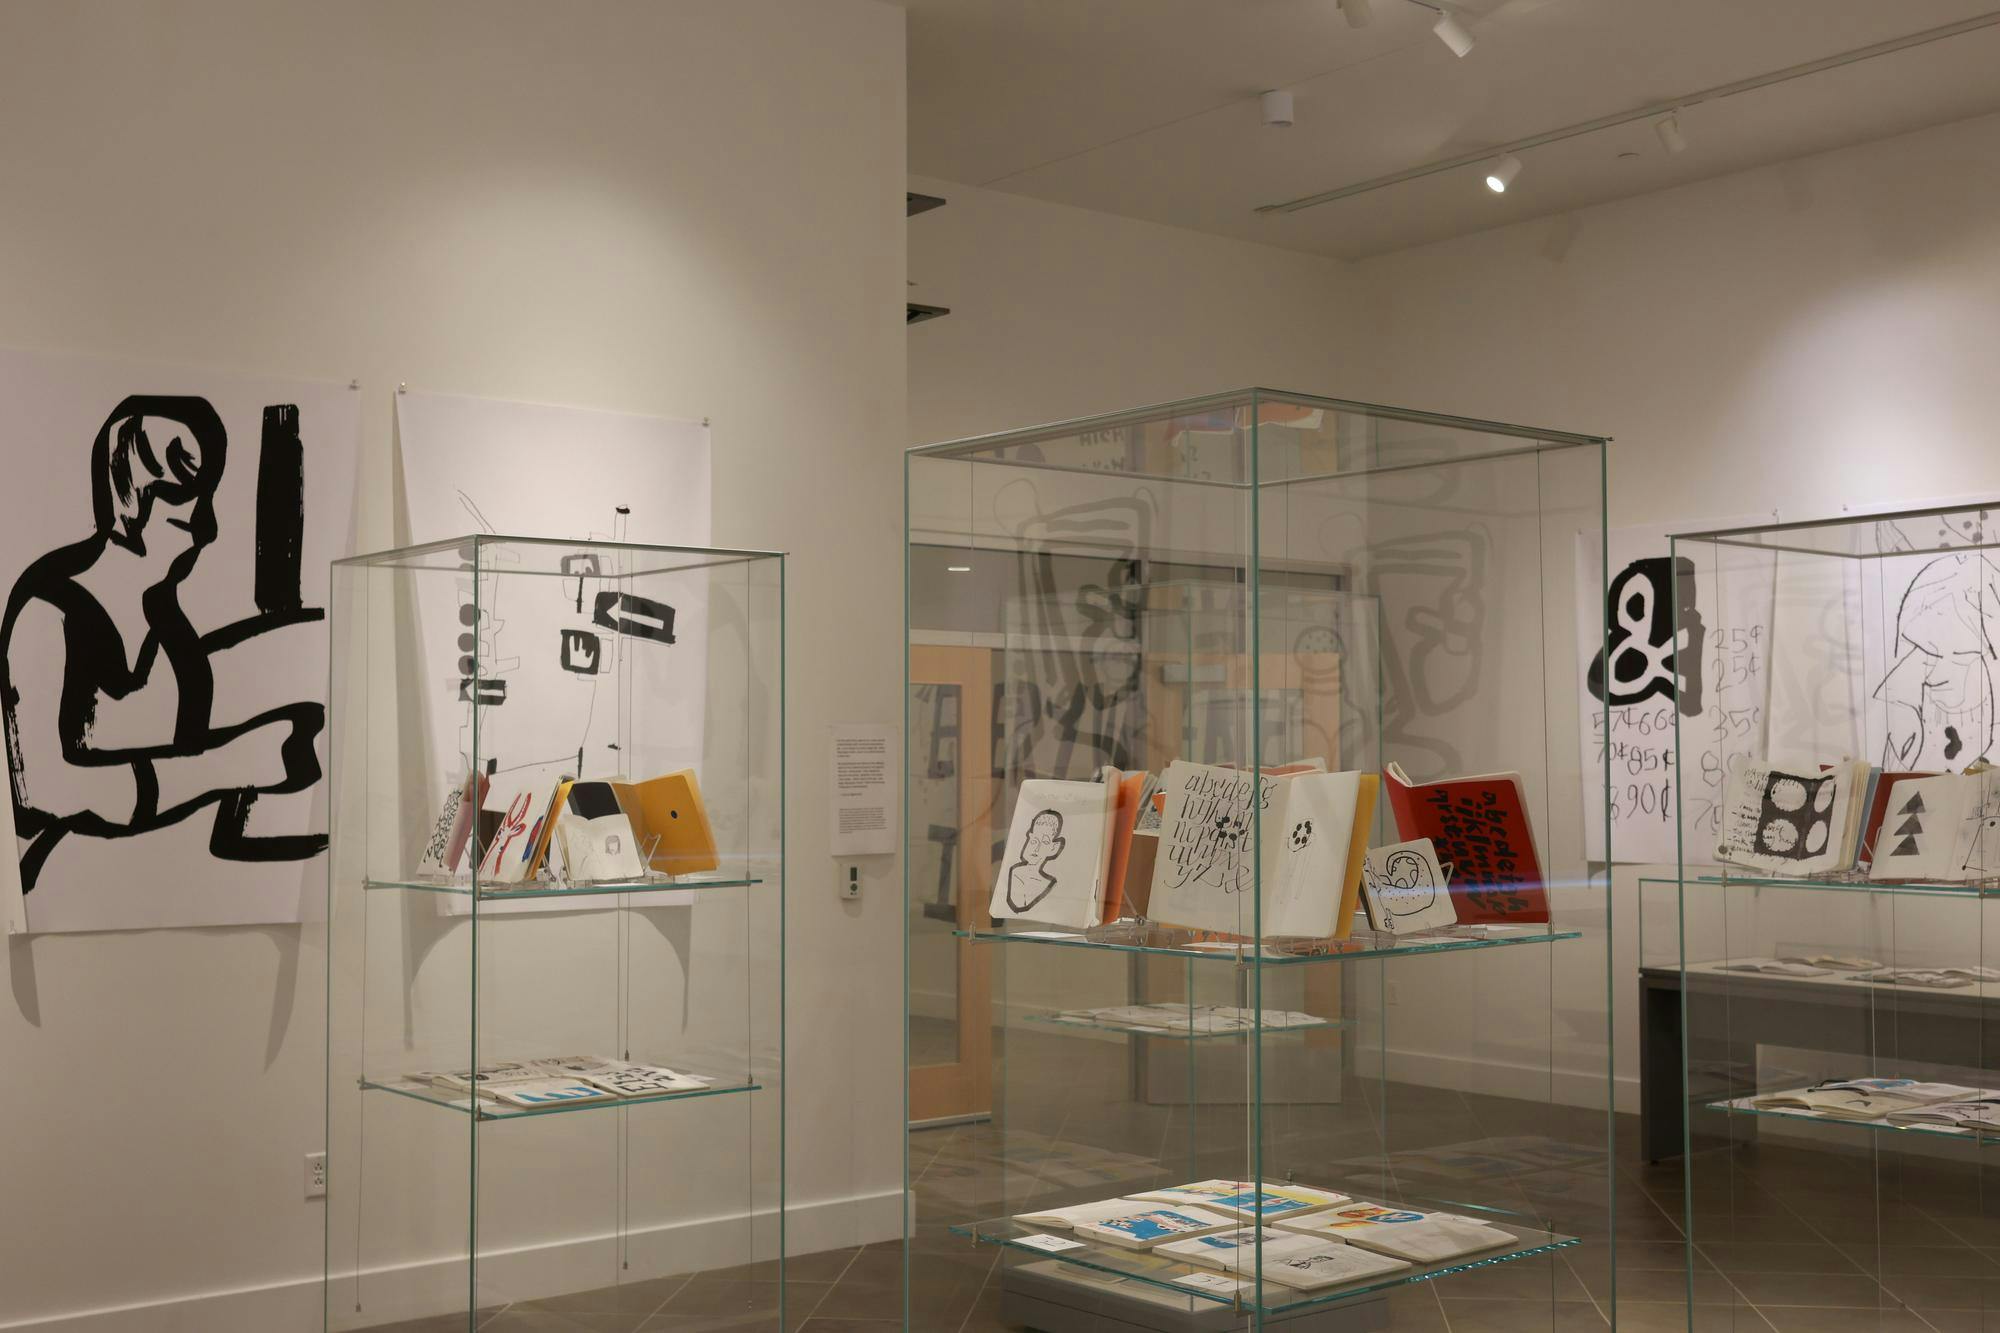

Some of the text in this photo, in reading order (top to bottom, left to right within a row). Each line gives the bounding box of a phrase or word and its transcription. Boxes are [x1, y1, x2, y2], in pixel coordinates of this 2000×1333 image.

[1710, 625, 1763, 653] 25¢
[1712, 652, 1761, 693] 25¢
[1627, 746, 1675, 776] 85¢
